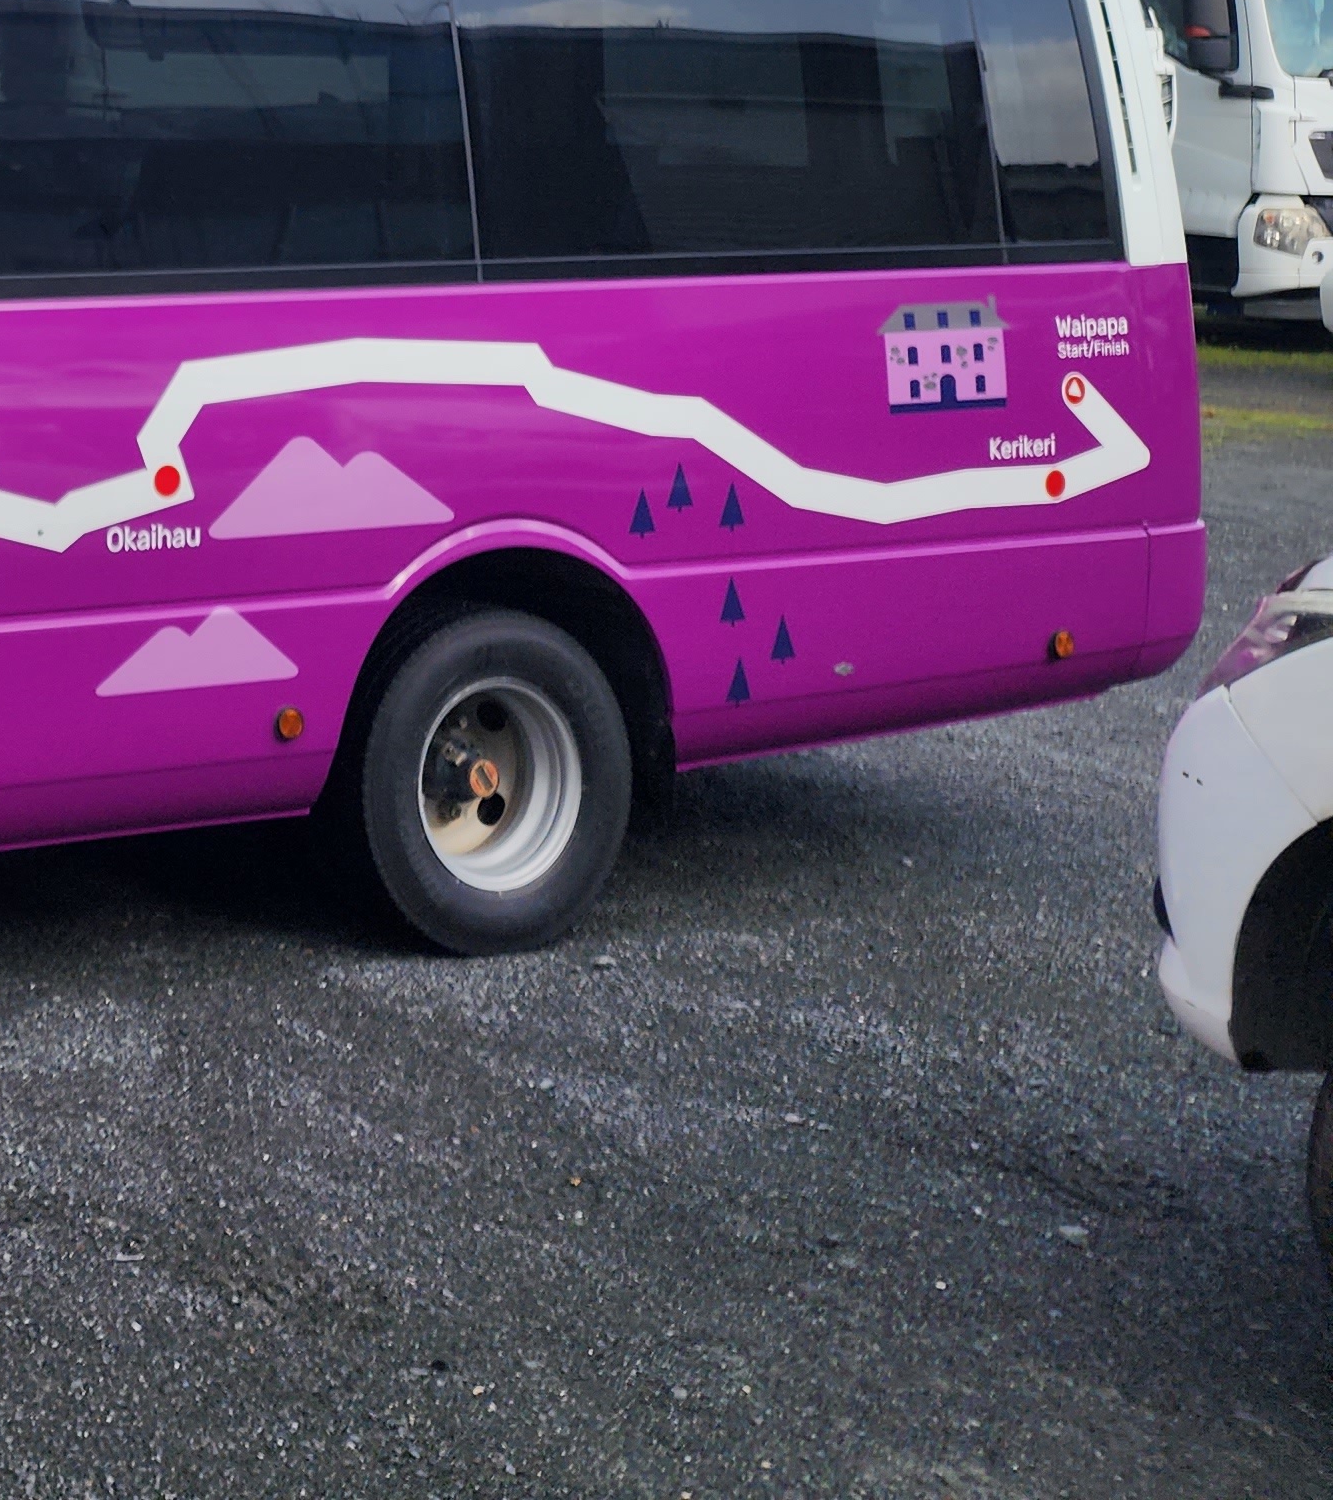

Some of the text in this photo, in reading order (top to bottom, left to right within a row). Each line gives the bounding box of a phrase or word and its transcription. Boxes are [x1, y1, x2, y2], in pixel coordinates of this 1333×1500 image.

[1055, 314, 1129, 341] Waipapa
[1057, 338, 1130, 359] Start/Finish
[989, 432, 1056, 461] Kerikeri
[106, 523, 201, 553] Okaihau
